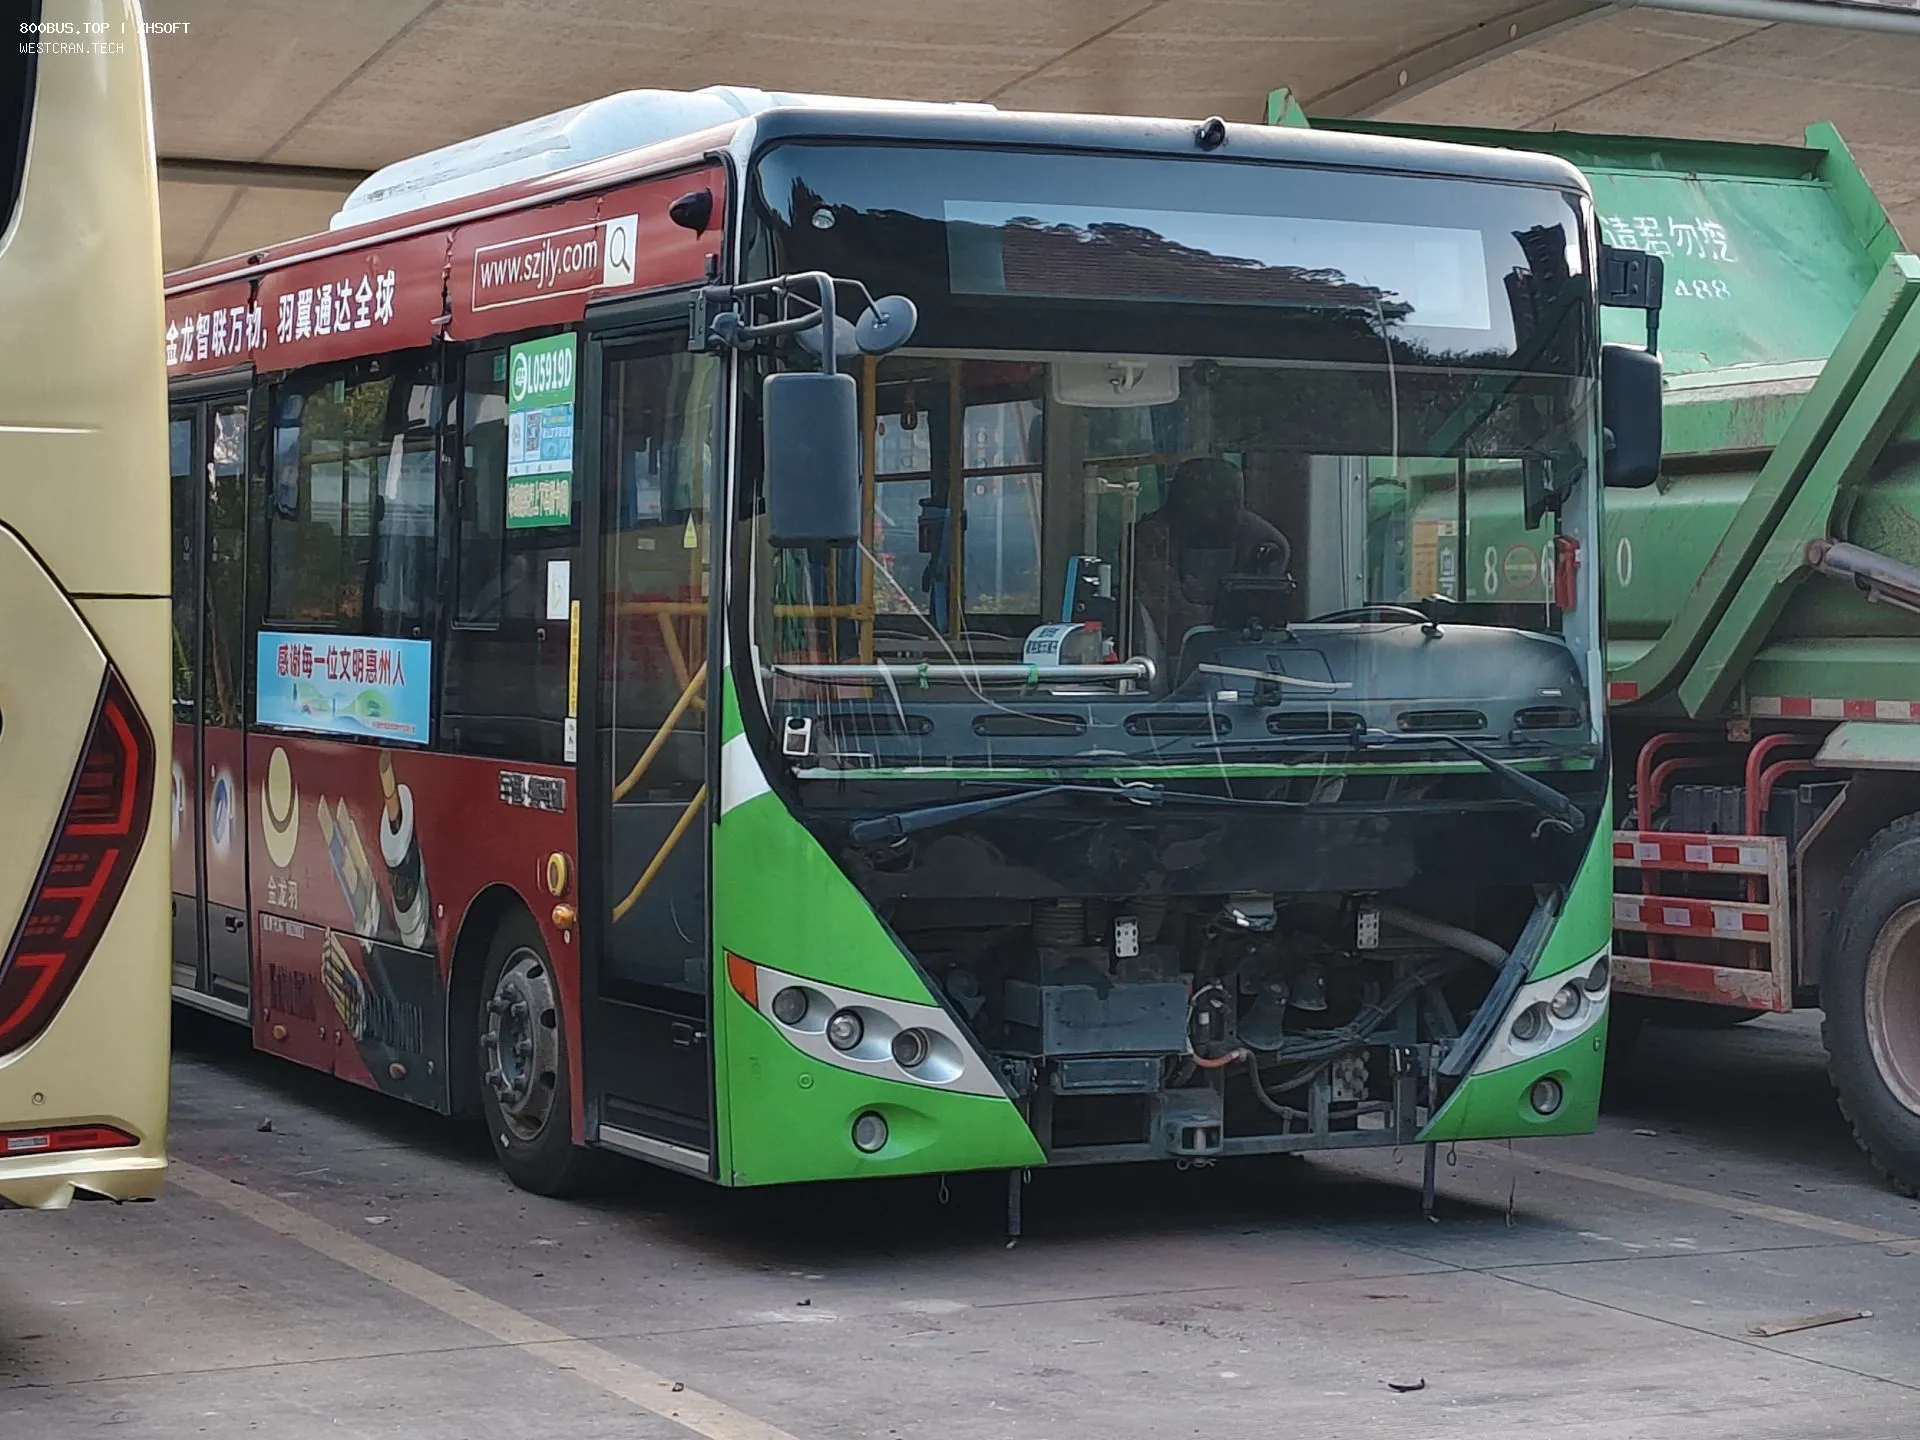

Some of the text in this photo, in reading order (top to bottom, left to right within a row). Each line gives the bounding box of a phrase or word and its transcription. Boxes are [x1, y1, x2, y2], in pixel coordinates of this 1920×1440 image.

[480, 238, 598, 289] www.szjly.com
[277, 643, 406, 687] 感谢每一位文明惠州人
[267, 875, 298, 910] 金龙羽
